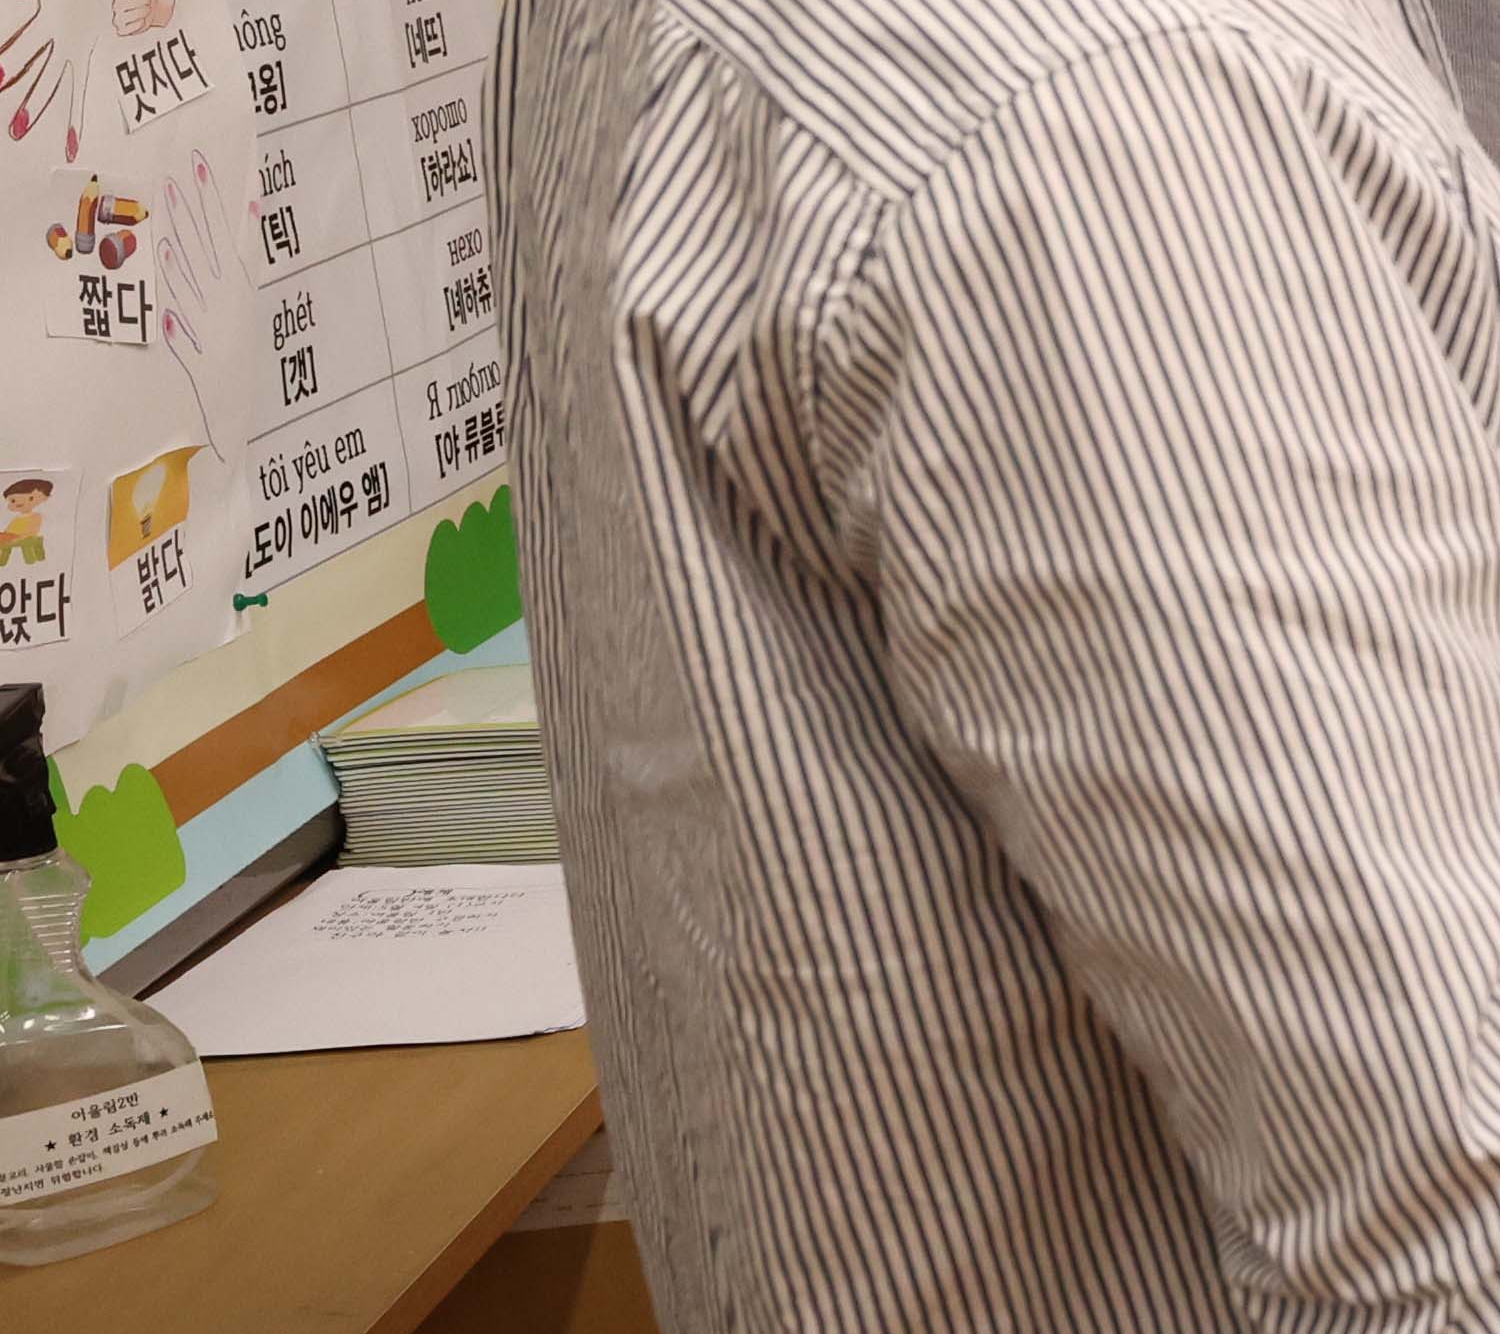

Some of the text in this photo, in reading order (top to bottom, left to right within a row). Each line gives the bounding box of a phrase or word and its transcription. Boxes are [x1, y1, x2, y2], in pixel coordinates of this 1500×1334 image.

[115, 28, 209, 123] 멋지다
[410, 97, 469, 145] хорошо
[78, 274, 153, 343] 짧다
[272, 289, 317, 351] ghét
[426, 381, 443, 421] Я
[258, 427, 368, 501] tôi yêu em
[136, 529, 187, 615] 밝다
[71, 1091, 141, 1122] 어울림2반
